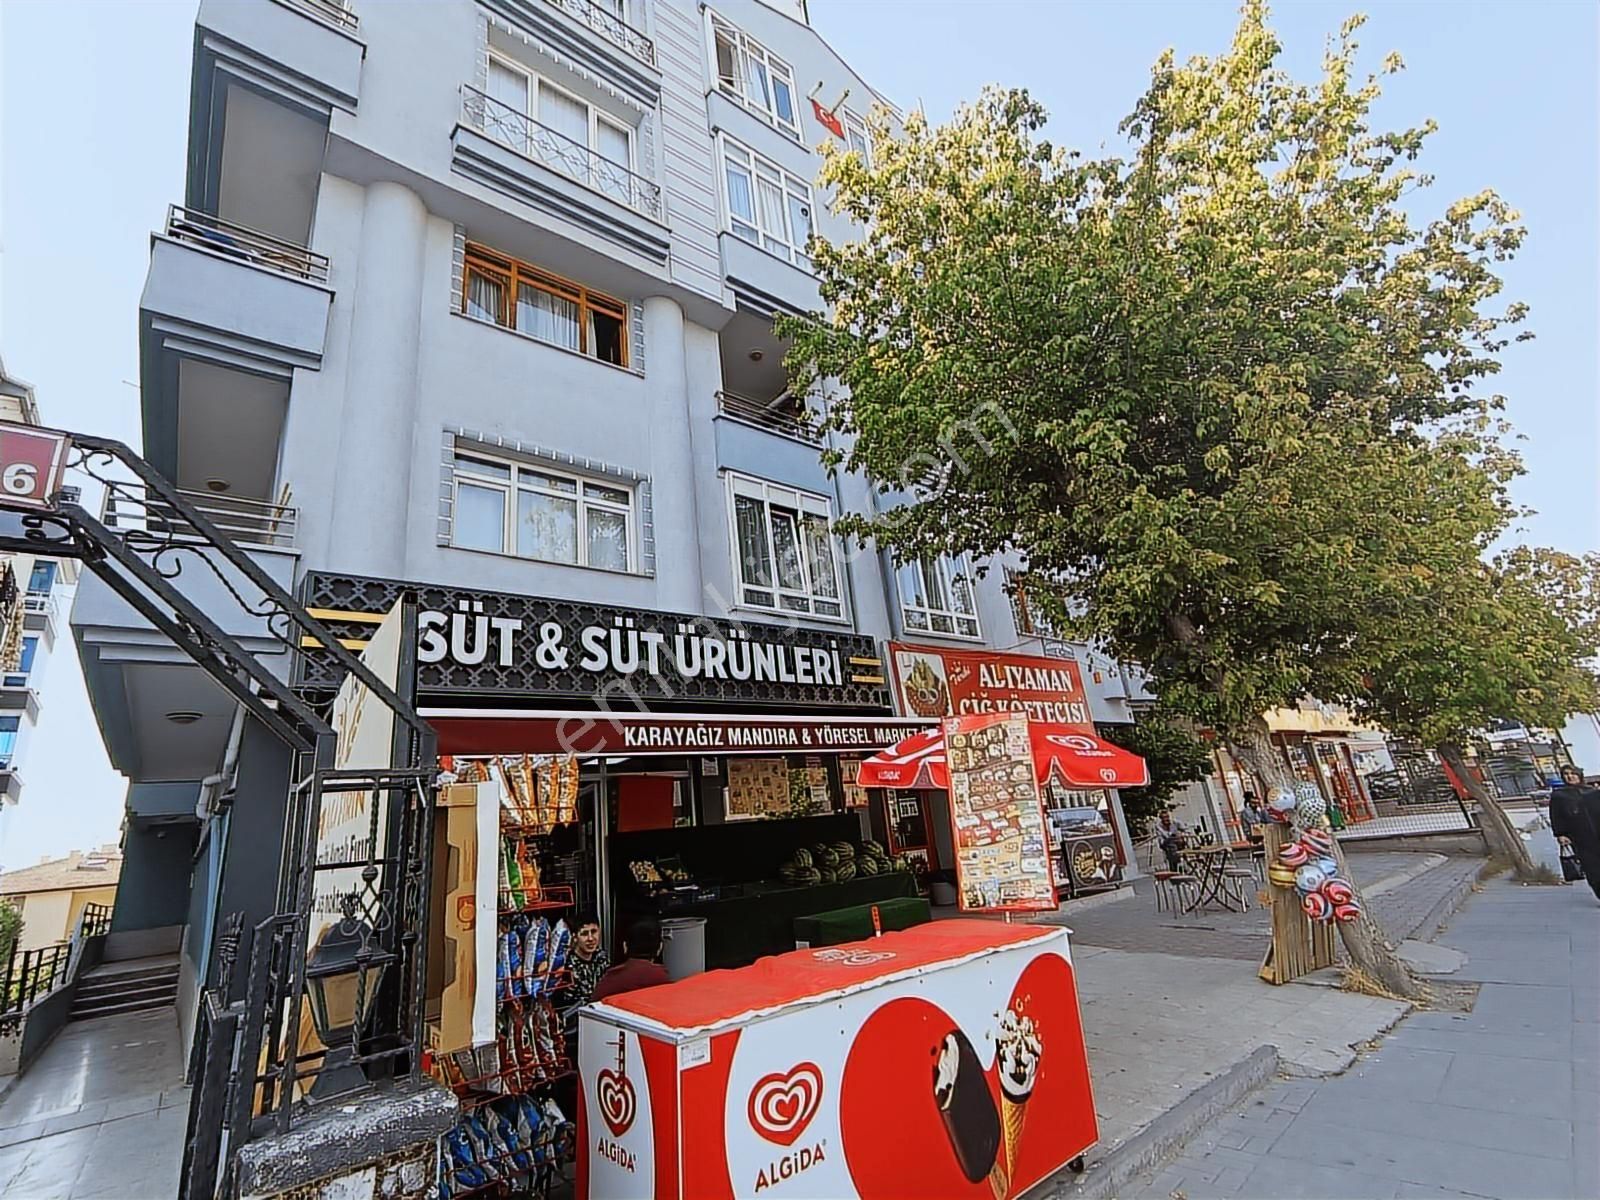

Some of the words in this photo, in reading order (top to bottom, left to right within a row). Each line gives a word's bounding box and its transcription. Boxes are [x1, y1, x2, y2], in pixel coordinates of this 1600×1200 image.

[3, 463, 38, 495] 6
[418, 600, 522, 667] SÜT
[535, 622, 569, 670] &
[580, 616, 664, 675] SÜT
[675, 623, 842, 686] ÜRÜNLERİ
[624, 723, 724, 747] KARAYAĞIZ
[727, 727, 799, 746] MANDIRA
[801, 728, 812, 745] &
[814, 725, 873, 744] YÖRESEL
